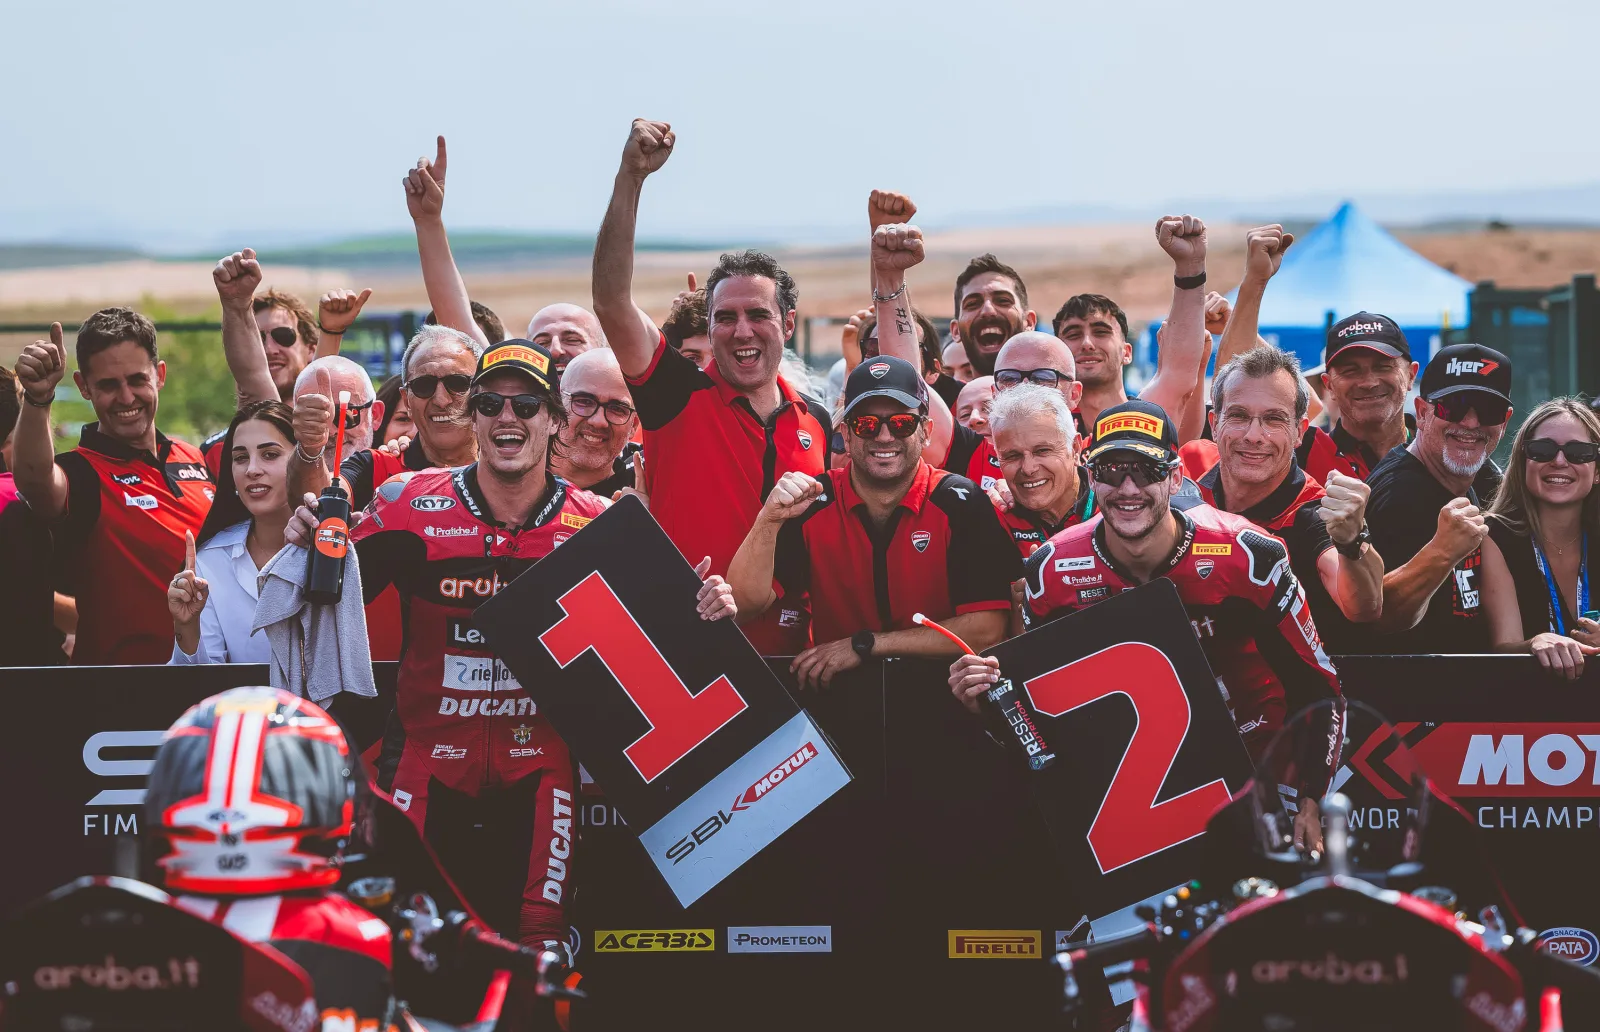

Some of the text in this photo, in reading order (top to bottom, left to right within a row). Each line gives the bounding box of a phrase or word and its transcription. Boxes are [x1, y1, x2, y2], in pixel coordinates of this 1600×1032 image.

[1338, 320, 1383, 337] aruba.it
[487, 347, 545, 369] PIRELLI
[1446, 357, 1499, 376] iker7
[1100, 415, 1158, 436] PIRELLI
[414, 499, 453, 509] KYT
[436, 525, 479, 537] Pratiche.it
[1013, 531, 1039, 540] novo
[1170, 530, 1194, 566] aruba.it
[1058, 560, 1092, 568] LS2
[1080, 587, 1107, 599] RESET
[537, 569, 749, 784] 1
[438, 696, 537, 717] DUCATI
[1002, 706, 1042, 756] RESET
[1014, 700, 1047, 749] NUTRITION
[1023, 641, 1233, 875] 2
[753, 746, 815, 799] MOTUL
[83, 813, 139, 836] FIM
[542, 787, 572, 905] DUCATI
[597, 931, 713, 950] ACERBIS
[1553, 929, 1581, 937] SNACK
[955, 936, 1037, 955] PIRELLI
[1549, 941, 1585, 955] PATA
